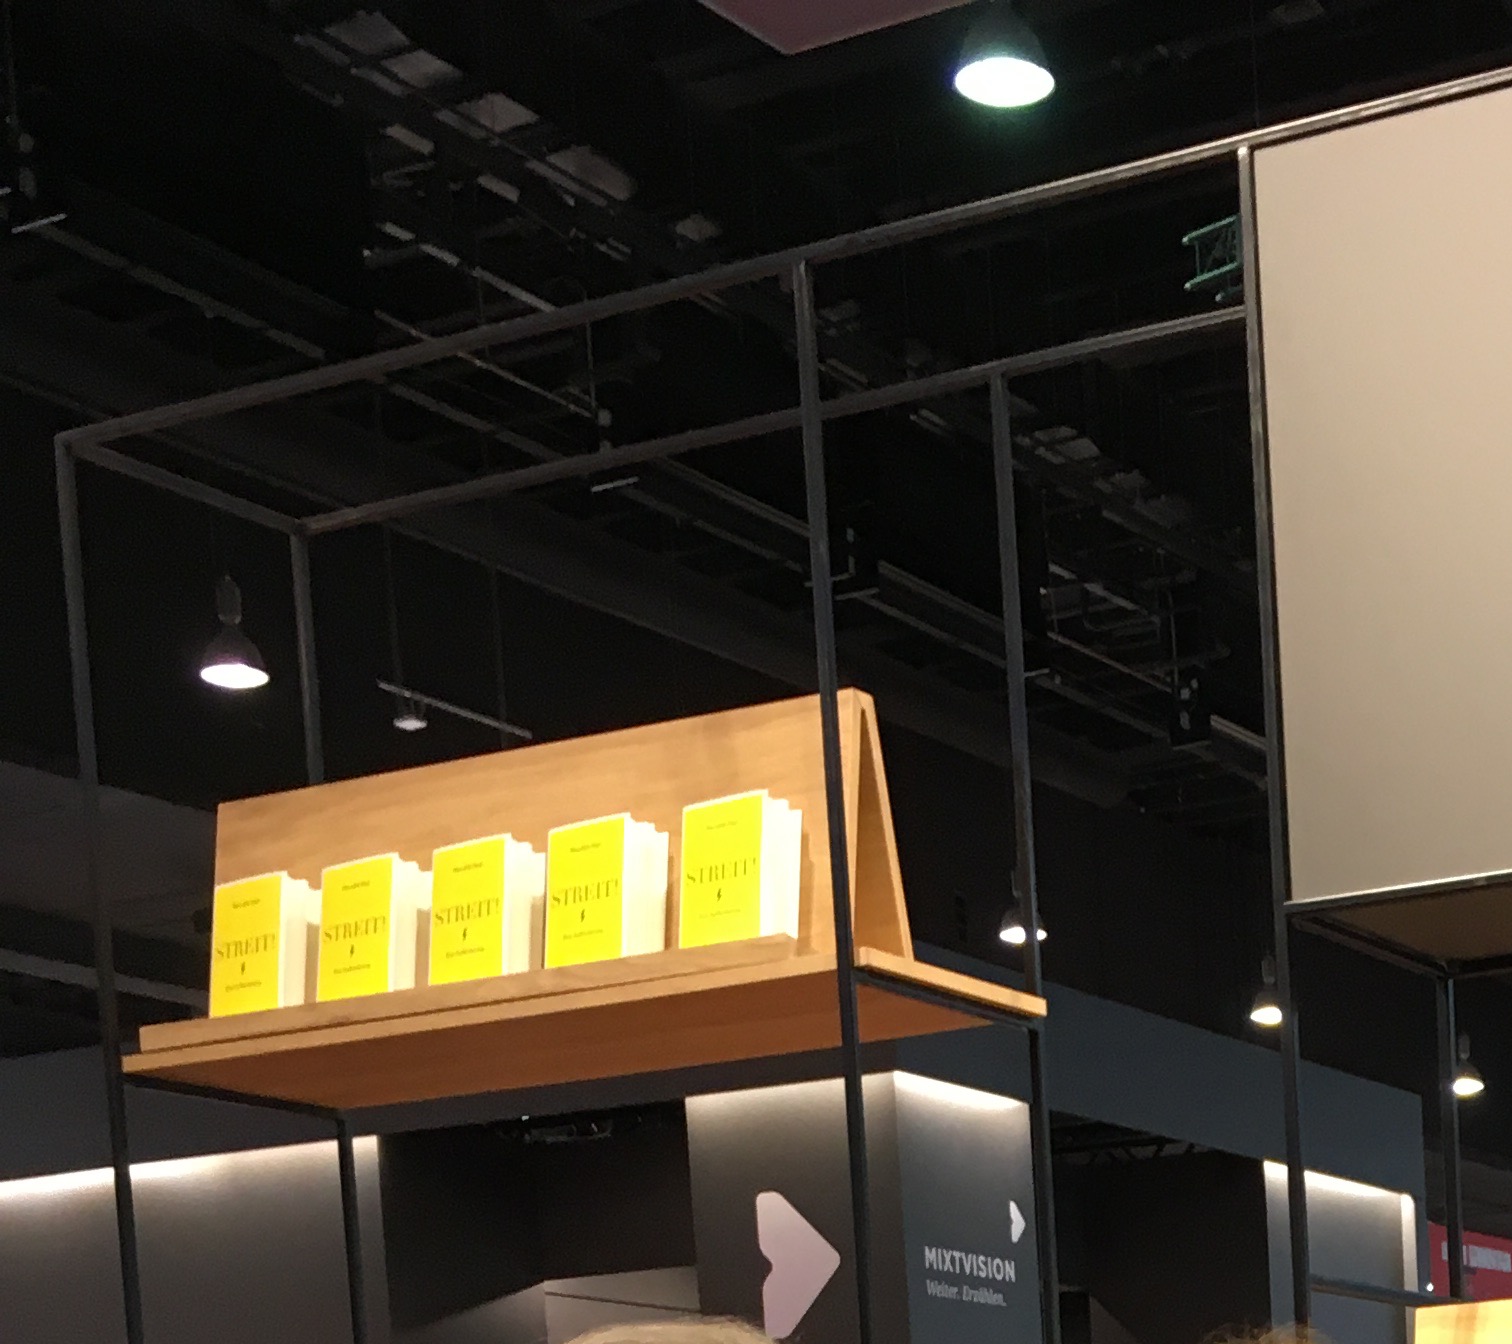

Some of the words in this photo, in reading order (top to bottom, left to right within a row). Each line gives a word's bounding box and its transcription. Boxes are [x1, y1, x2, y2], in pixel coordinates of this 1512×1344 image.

[552, 878, 619, 909] STREIT!
[435, 897, 501, 926] STREIT!
[323, 915, 386, 942] STREIT!
[214, 933, 276, 960] STREIT!
[925, 1245, 1015, 1282] MIXTVISION
